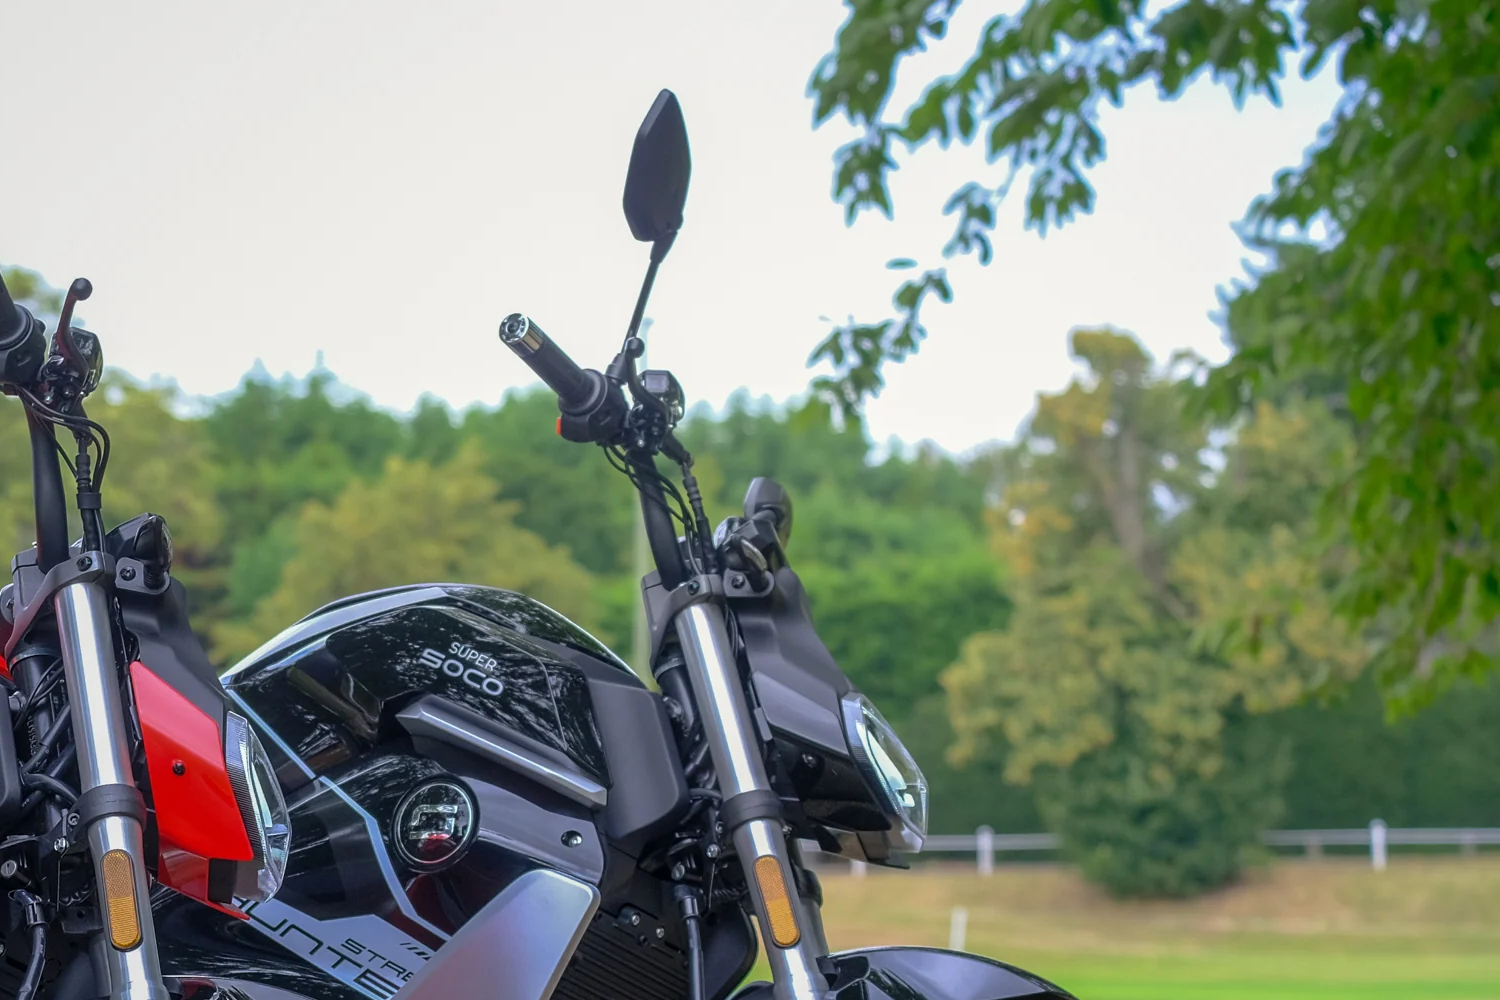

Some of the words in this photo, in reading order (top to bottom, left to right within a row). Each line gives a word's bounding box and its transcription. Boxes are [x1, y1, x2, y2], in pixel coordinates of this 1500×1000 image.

[419, 647, 504, 697] SOCO
[448, 641, 498, 672] SUPER
[232, 896, 401, 1000] UNTE
[340, 937, 415, 982] STRE
